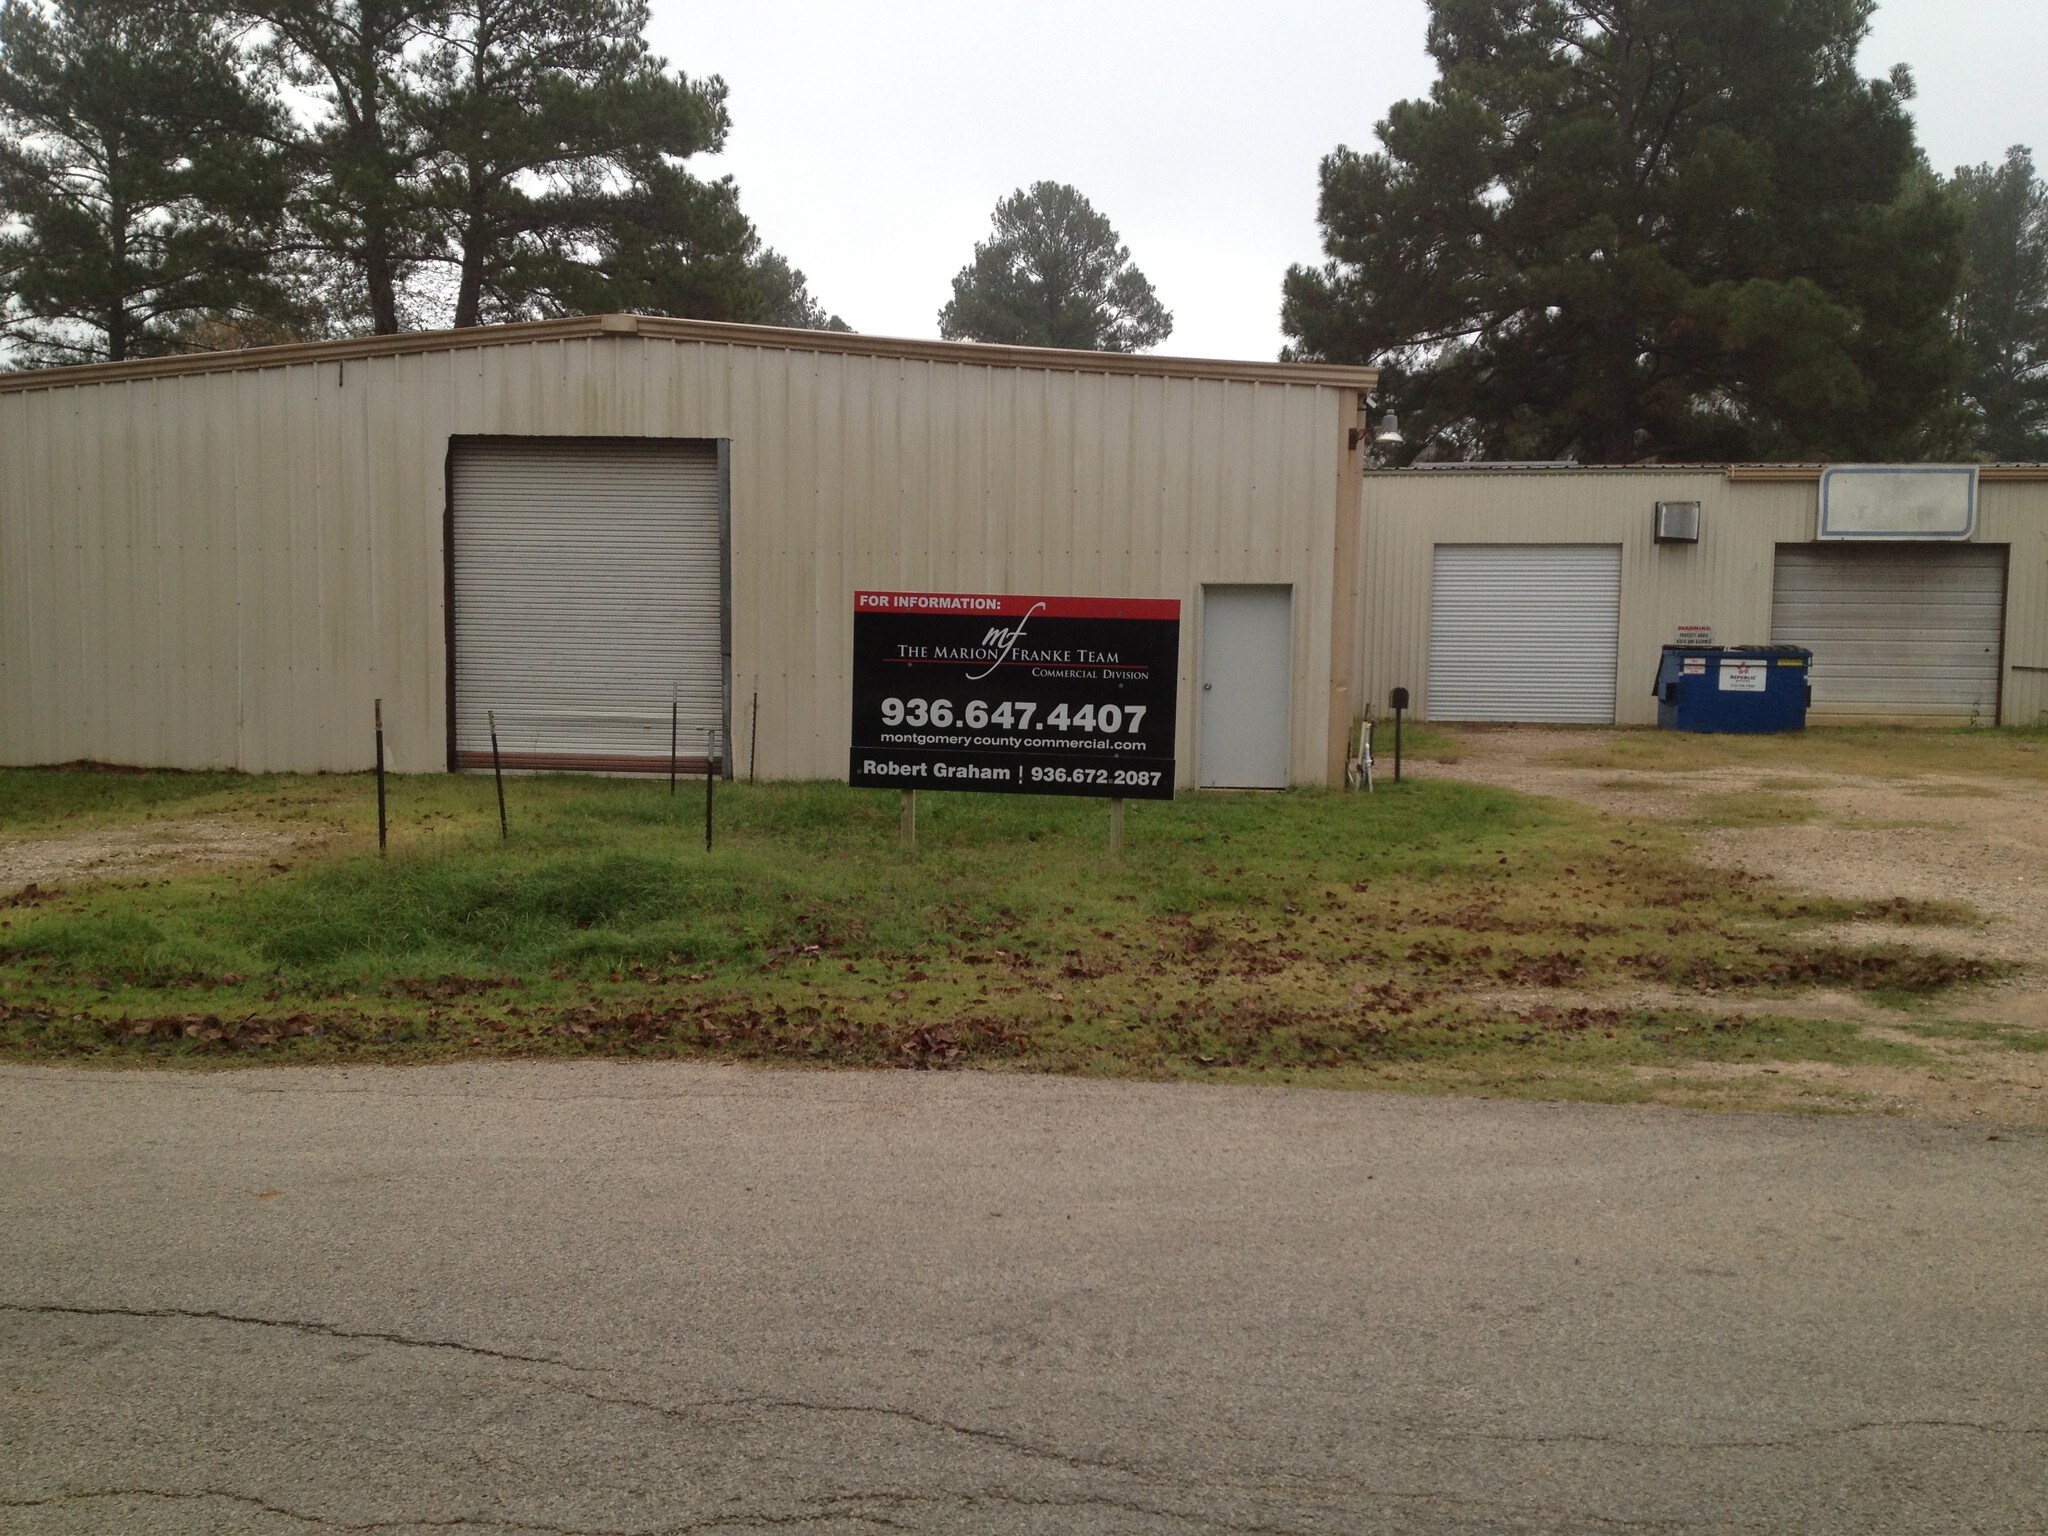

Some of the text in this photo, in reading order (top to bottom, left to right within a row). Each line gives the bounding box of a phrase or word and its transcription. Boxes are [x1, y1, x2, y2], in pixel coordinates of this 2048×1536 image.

[859, 594, 1001, 610] FOR INFORMATION:
[898, 644, 1119, 663] THE MARION FRANKE TEAM
[1032, 667, 1149, 680] COMMERCIAL DIVISION
[881, 697, 1147, 733] 936.647.4407
[863, 760, 1161, 787] Robert Graham 936.672.2087
